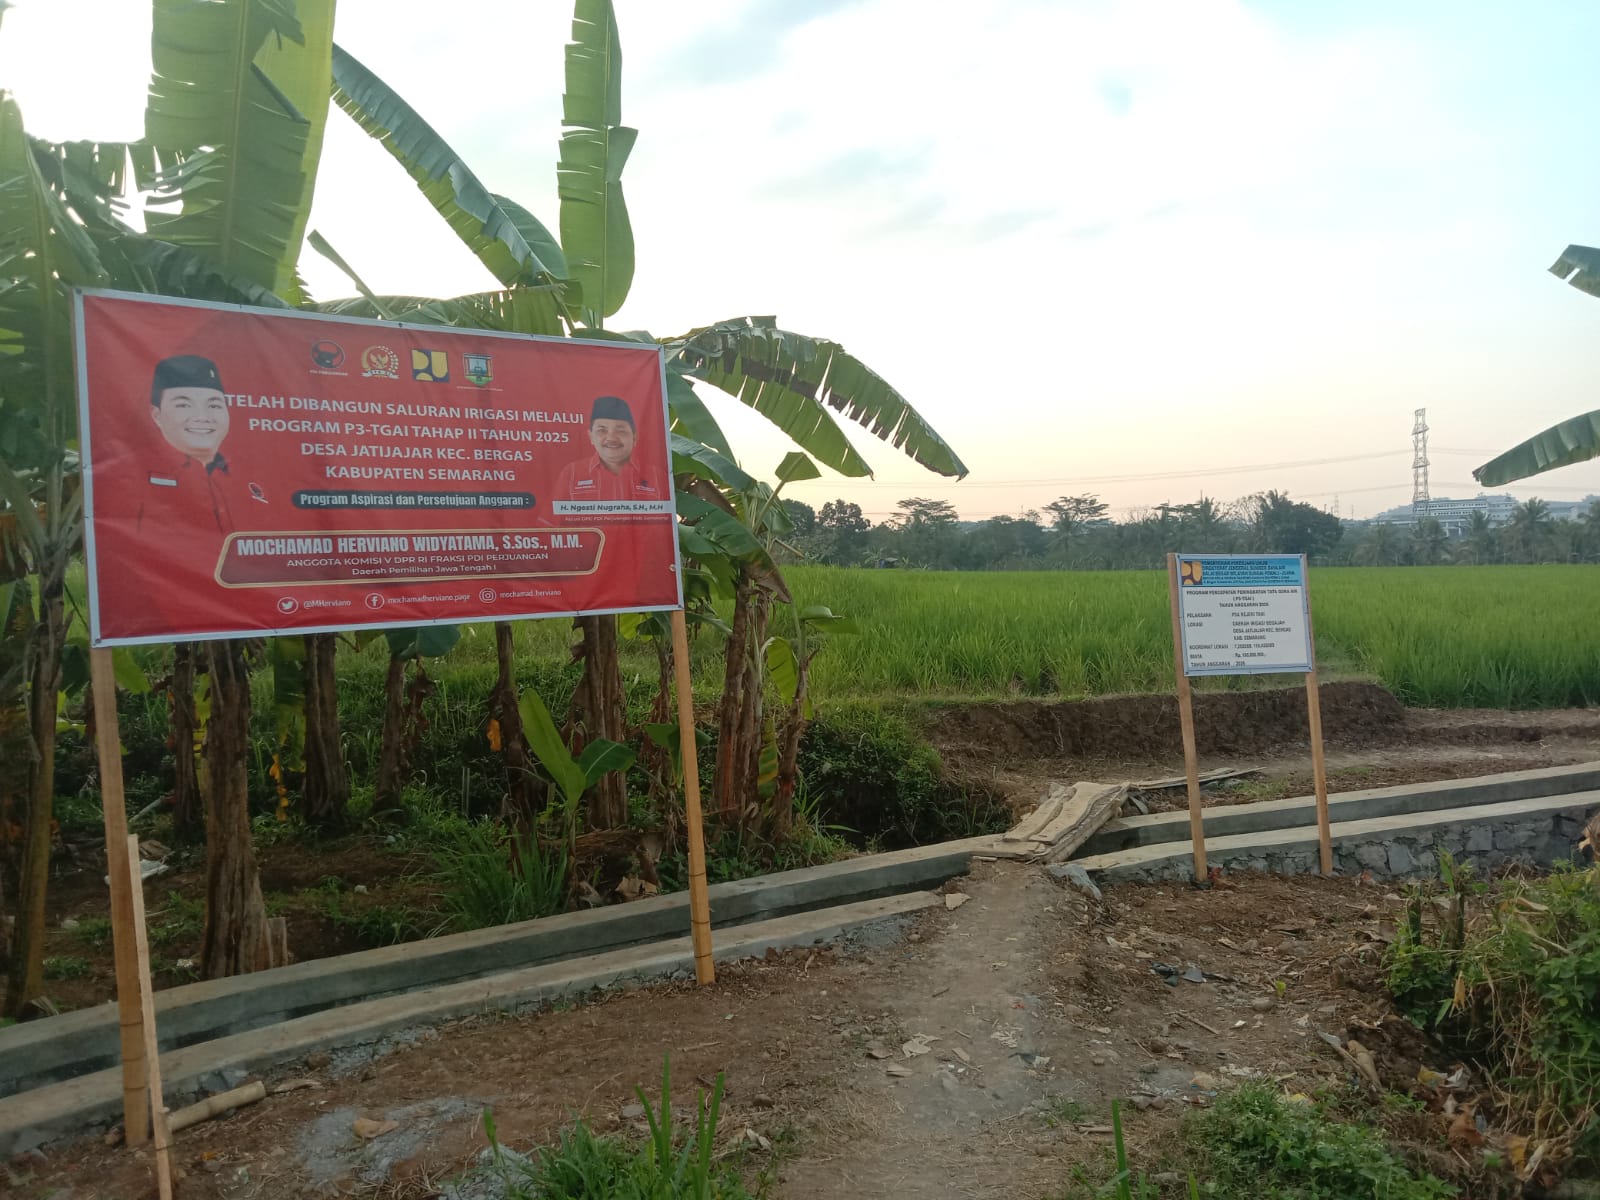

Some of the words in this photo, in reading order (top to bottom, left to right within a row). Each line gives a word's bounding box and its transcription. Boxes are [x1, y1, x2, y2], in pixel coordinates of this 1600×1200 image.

[224, 393, 285, 409] TELAH
[289, 396, 382, 415] DIBANGUN
[386, 402, 460, 419] SALURAN
[464, 407, 519, 421] IRIGASI
[523, 410, 584, 425] MELALUI
[249, 418, 341, 434] PROGRAM
[345, 422, 408, 437] P3-TGAI
[411, 425, 464, 439] TAHAP
[468, 428, 477, 440] II
[480, 428, 532, 442] TAHUN
[535, 431, 569, 443] 2025
[301, 442, 347, 456] DESA
[351, 444, 432, 460] JATIJAJAR
[436, 448, 471, 461] KEC.
[474, 449, 533, 462] BERGAS
[326, 465, 424, 480] KABUPATEN
[428, 468, 515, 482] SEMARANG
[300, 493, 348, 506] Program
[351, 492, 393, 506] Aspirasi
[396, 494, 415, 505] dan
[417, 494, 476, 507] Persetujuan
[479, 495, 523, 508] Anggaran
[237, 538, 333, 556] MOCHAMAD
[337, 536, 409, 553] HERVIANO
[412, 535, 499, 552] WIDYATAMA,
[502, 534, 548, 551] S.Sos.,
[550, 534, 583, 549] M.M.
[287, 558, 342, 567] ANGGOTA
[344, 557, 382, 566] KOMISI
[384, 556, 393, 564] V
[394, 556, 416, 564] DPR
[430, 555, 465, 563] FRAKSI
[467, 554, 484, 562] PDI
[486, 553, 549, 562] PERJUANGAN
[352, 567, 387, 576] Daerah
[389, 565, 433, 574] Pemilihan
[435, 565, 458, 573] Jawa
[460, 564, 491, 574] Tengah
